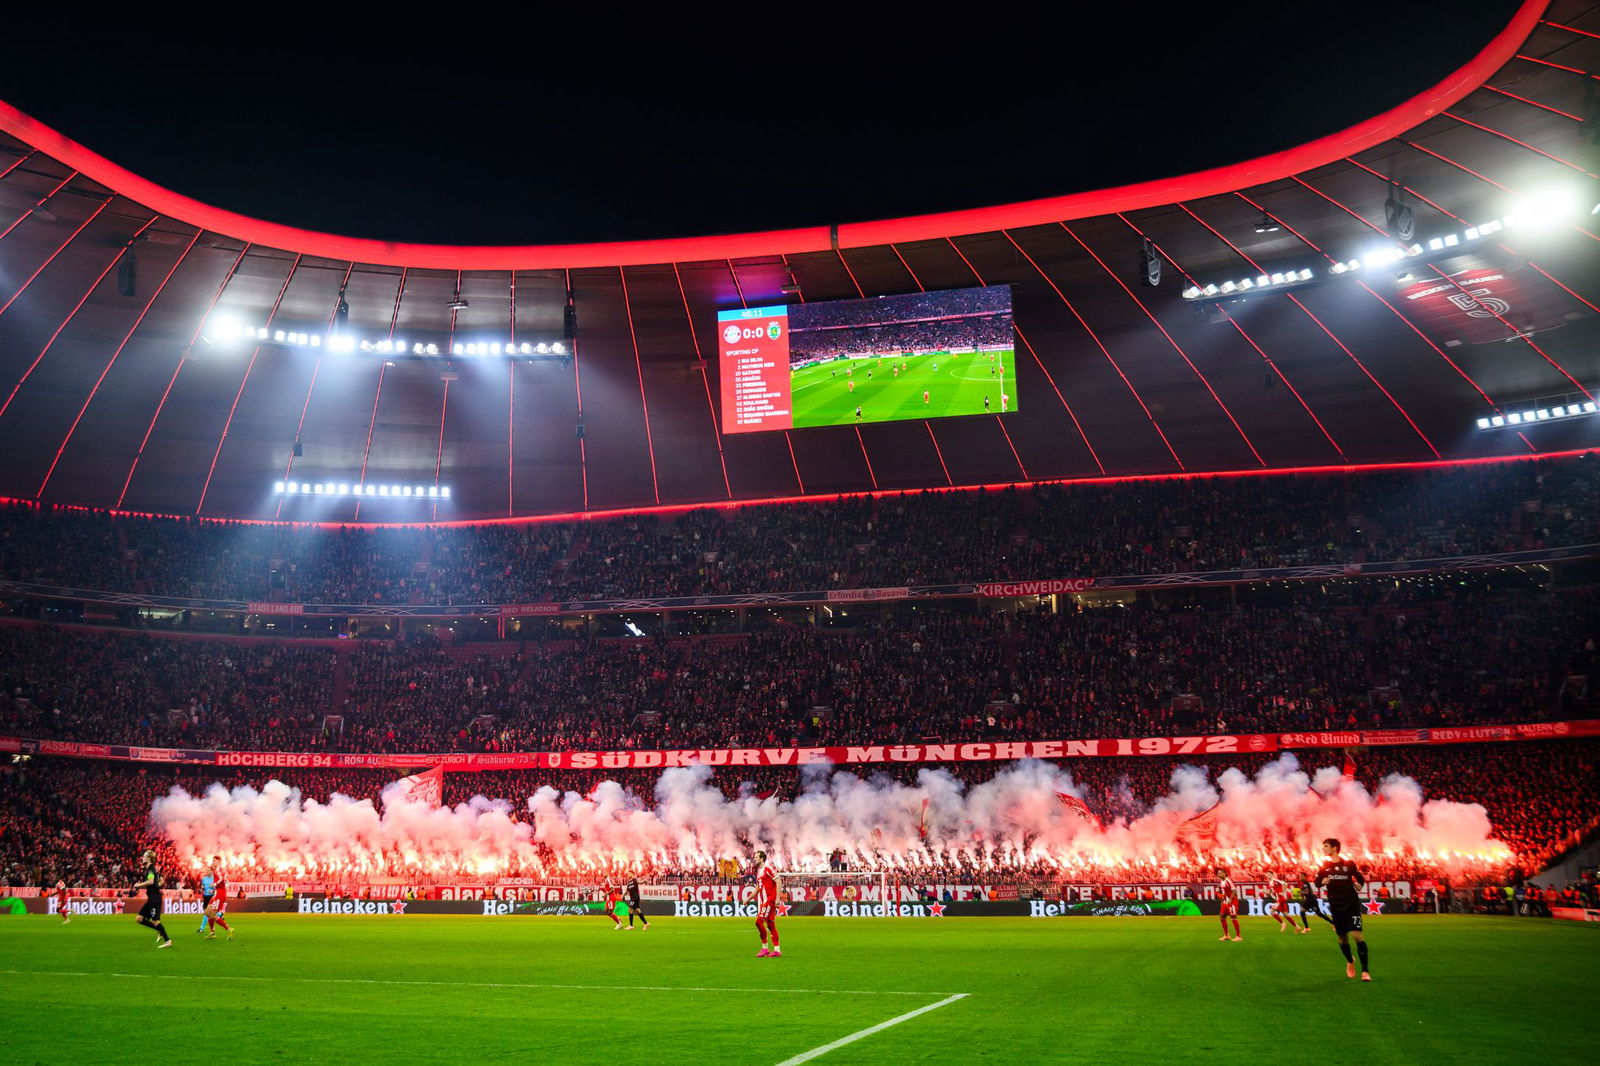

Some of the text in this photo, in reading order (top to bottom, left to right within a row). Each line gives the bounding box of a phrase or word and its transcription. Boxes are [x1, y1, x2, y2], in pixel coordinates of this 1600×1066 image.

[1446, 288, 1510, 318] 5
[743, 327, 764, 339] 0:0
[218, 752, 309, 767] HÖCHBERG
[571, 735, 1238, 769] SÜDKURVE MÜNCHEN 1972
[441, 882, 560, 902] alarstufe
[48, 898, 113, 915] Hineken
[164, 898, 221, 915] Heinek
[298, 897, 388, 914] Heineken
[674, 901, 758, 917] Heineke
[824, 900, 926, 917] Heineken
